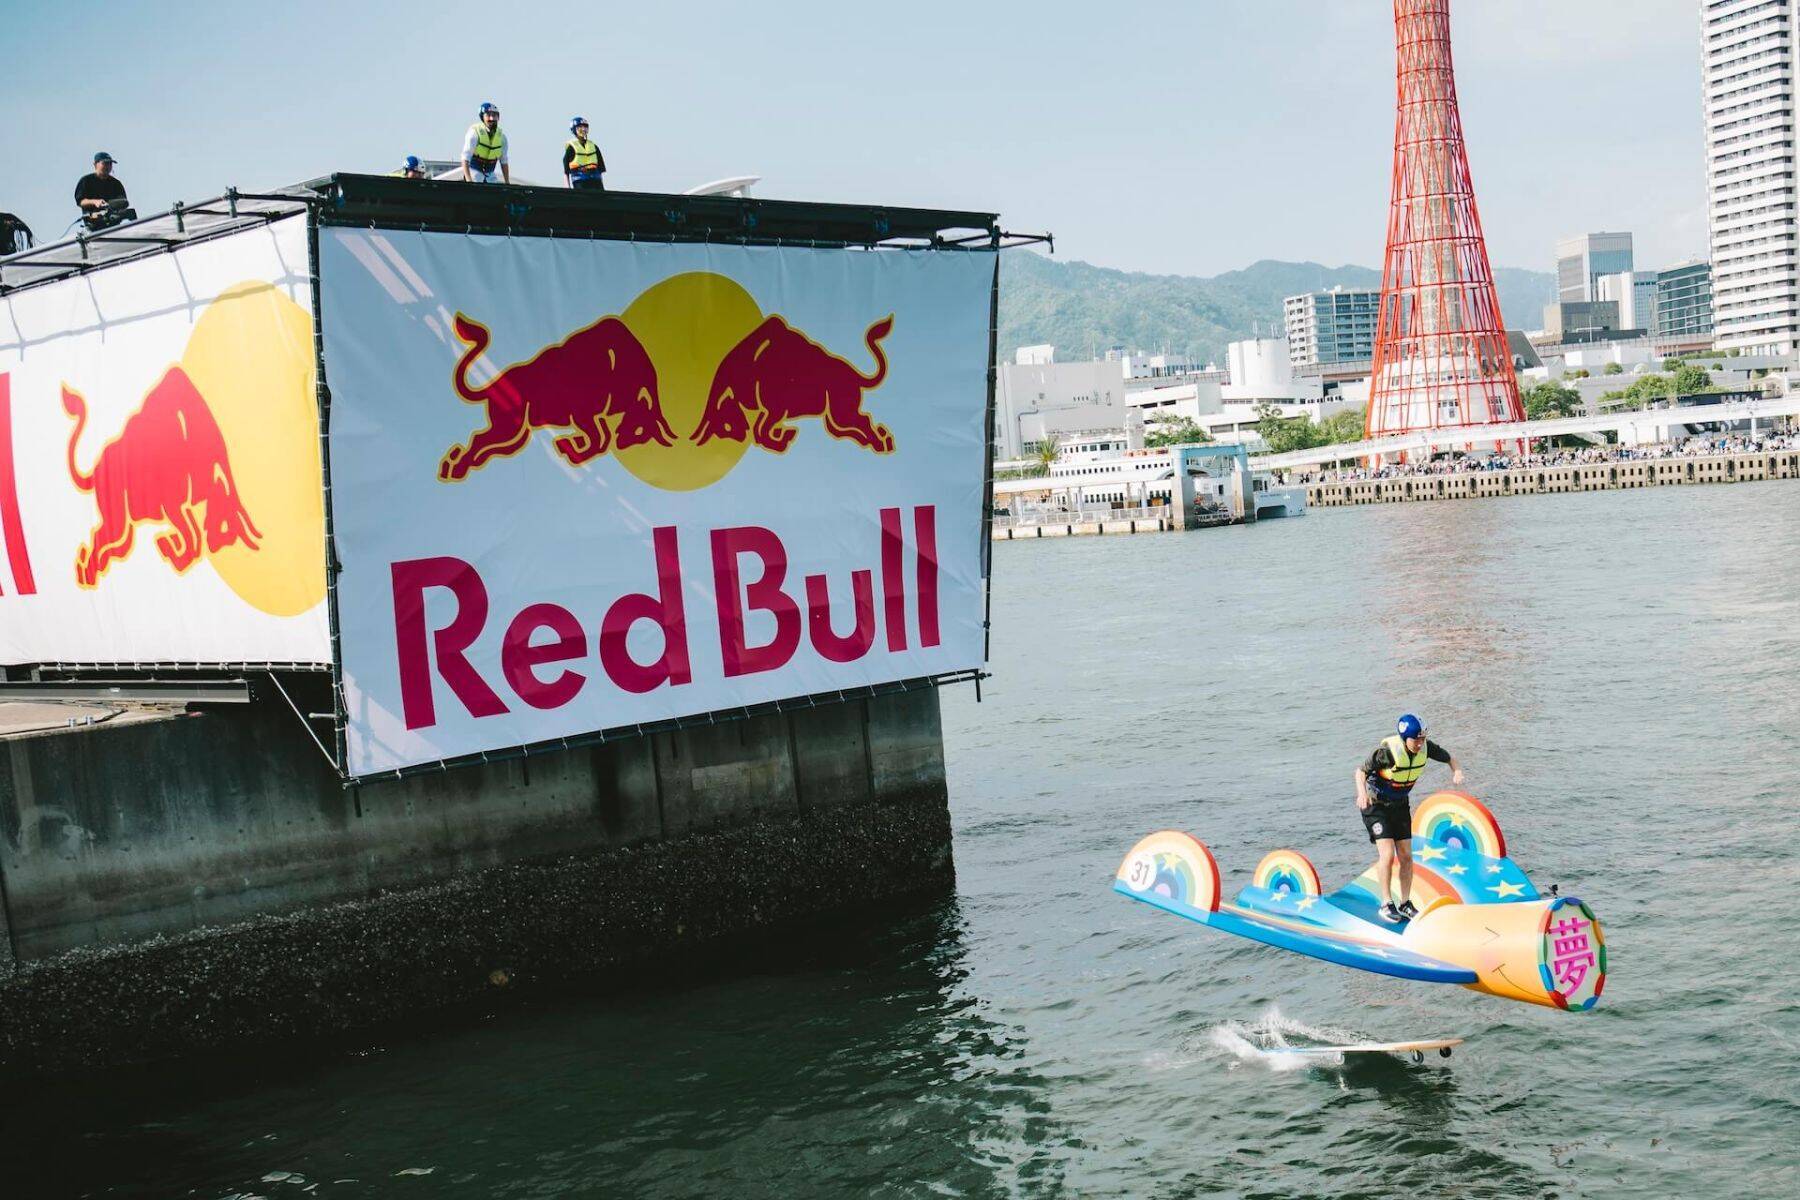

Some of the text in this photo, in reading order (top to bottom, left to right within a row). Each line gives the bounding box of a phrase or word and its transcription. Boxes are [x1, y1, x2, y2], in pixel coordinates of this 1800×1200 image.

[391, 505, 941, 731] Red Bull
[1131, 860, 1150, 886] 31
[1549, 917, 1596, 999] 夢
